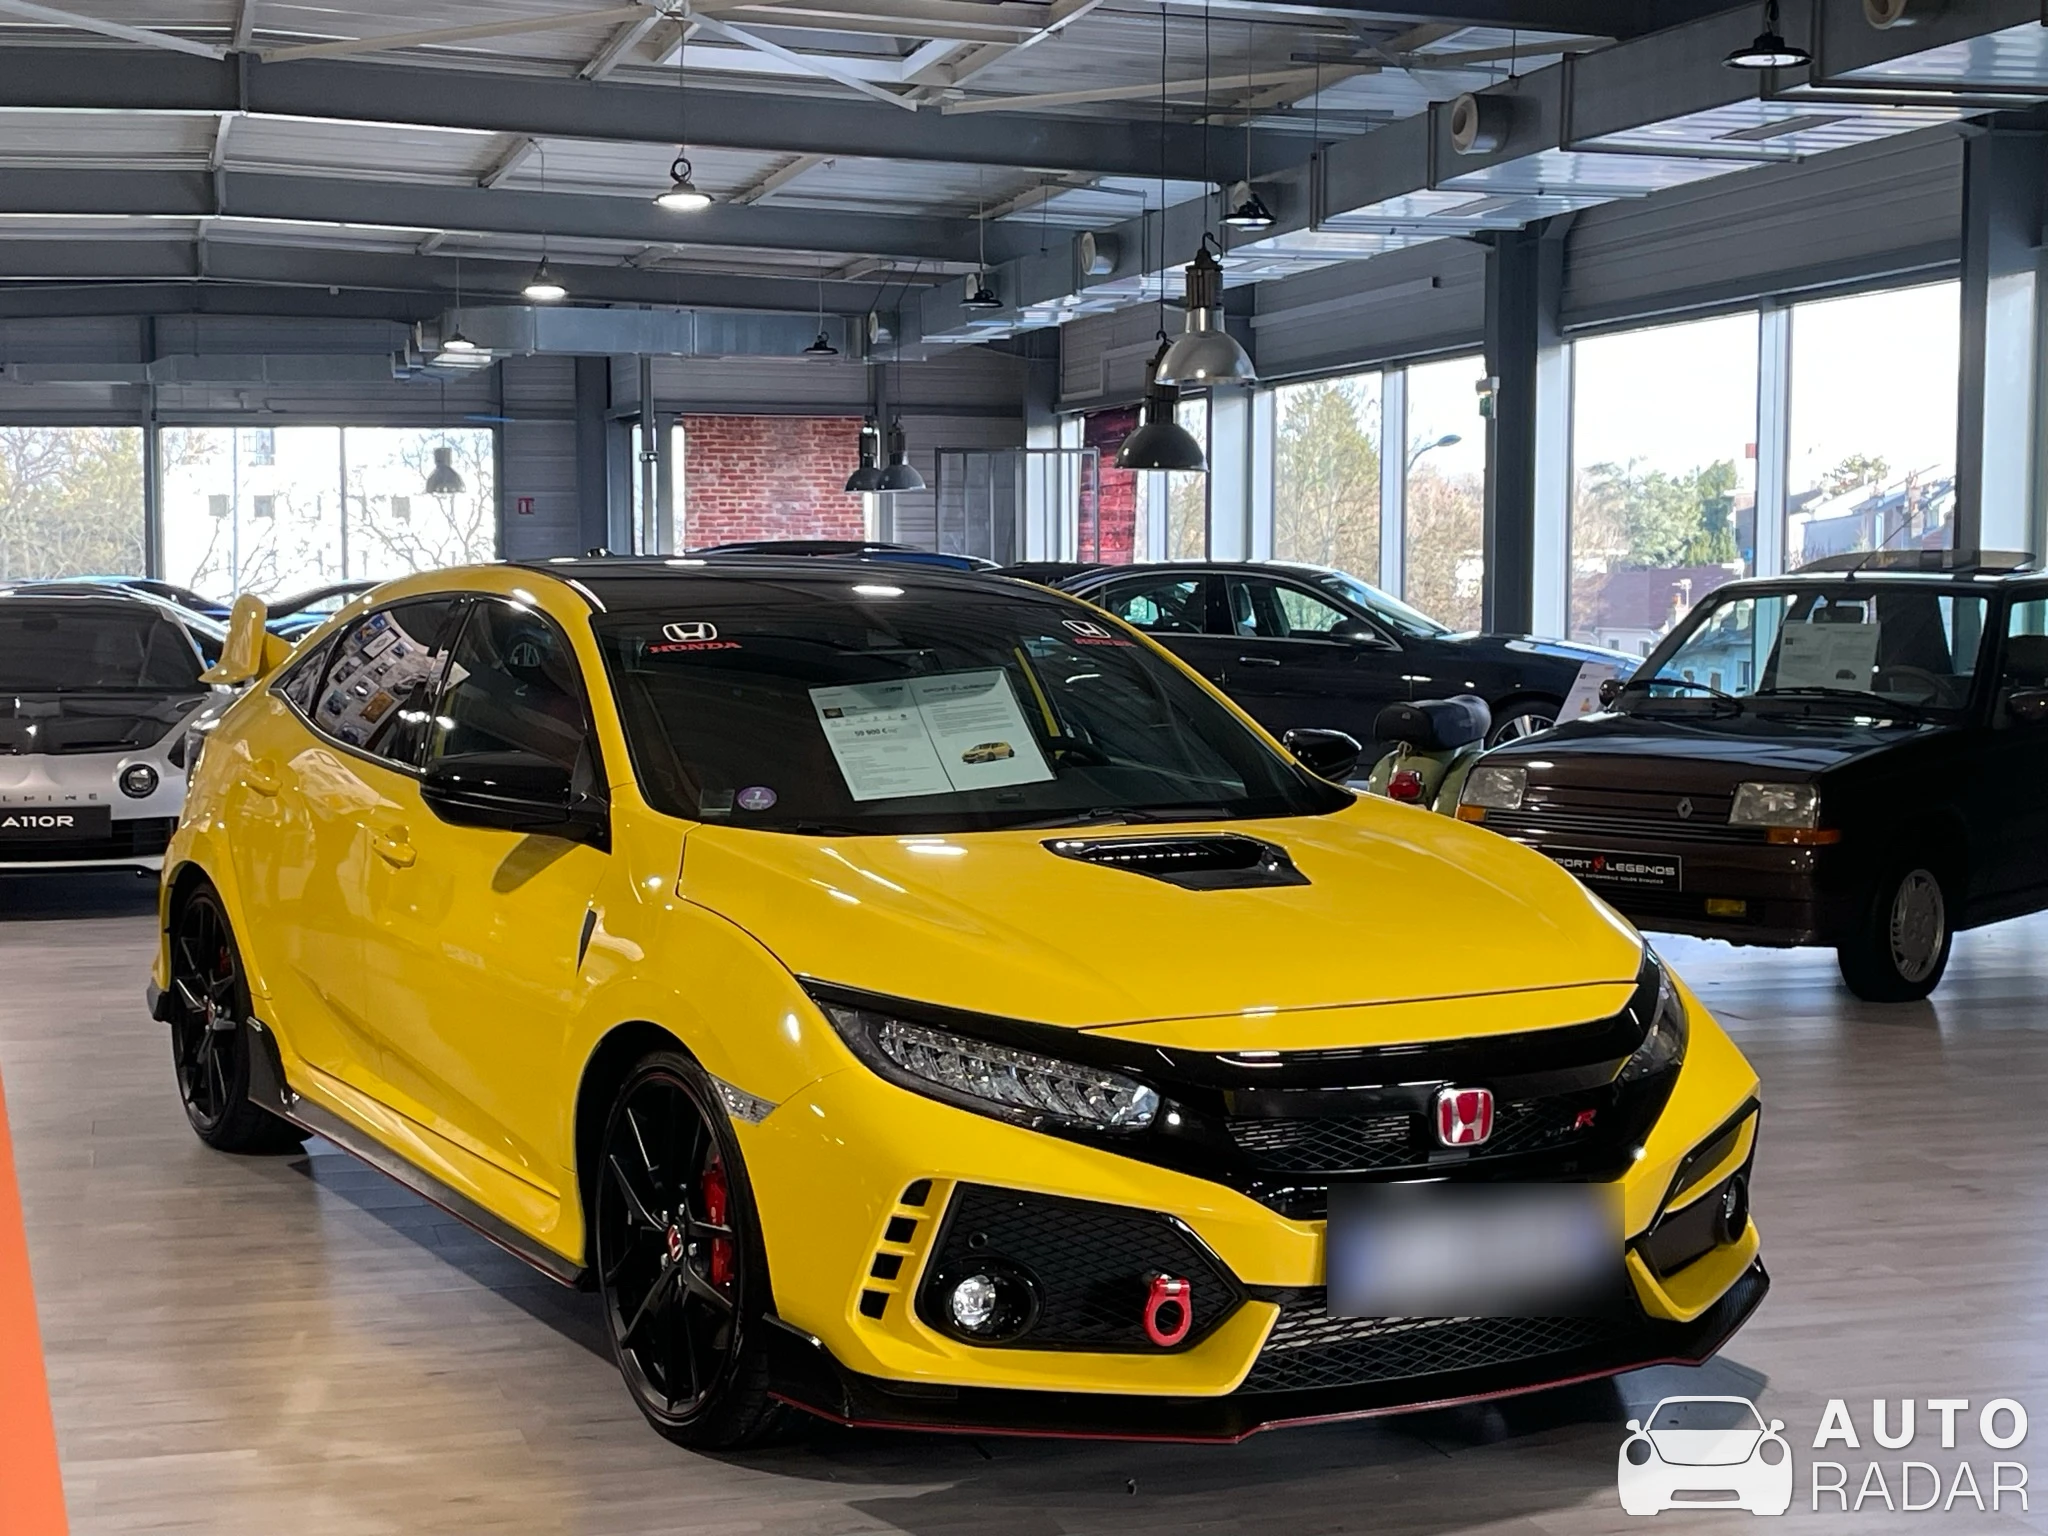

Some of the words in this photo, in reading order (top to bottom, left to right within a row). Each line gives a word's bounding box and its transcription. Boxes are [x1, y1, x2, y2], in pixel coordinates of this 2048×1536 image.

[649, 642, 743, 654] HONDA
[2, 793, 98, 802] LPINE
[1, 815, 74, 828] A110R
[1552, 857, 1592, 868] PORT
[1605, 861, 1675, 876] LEGENDS
